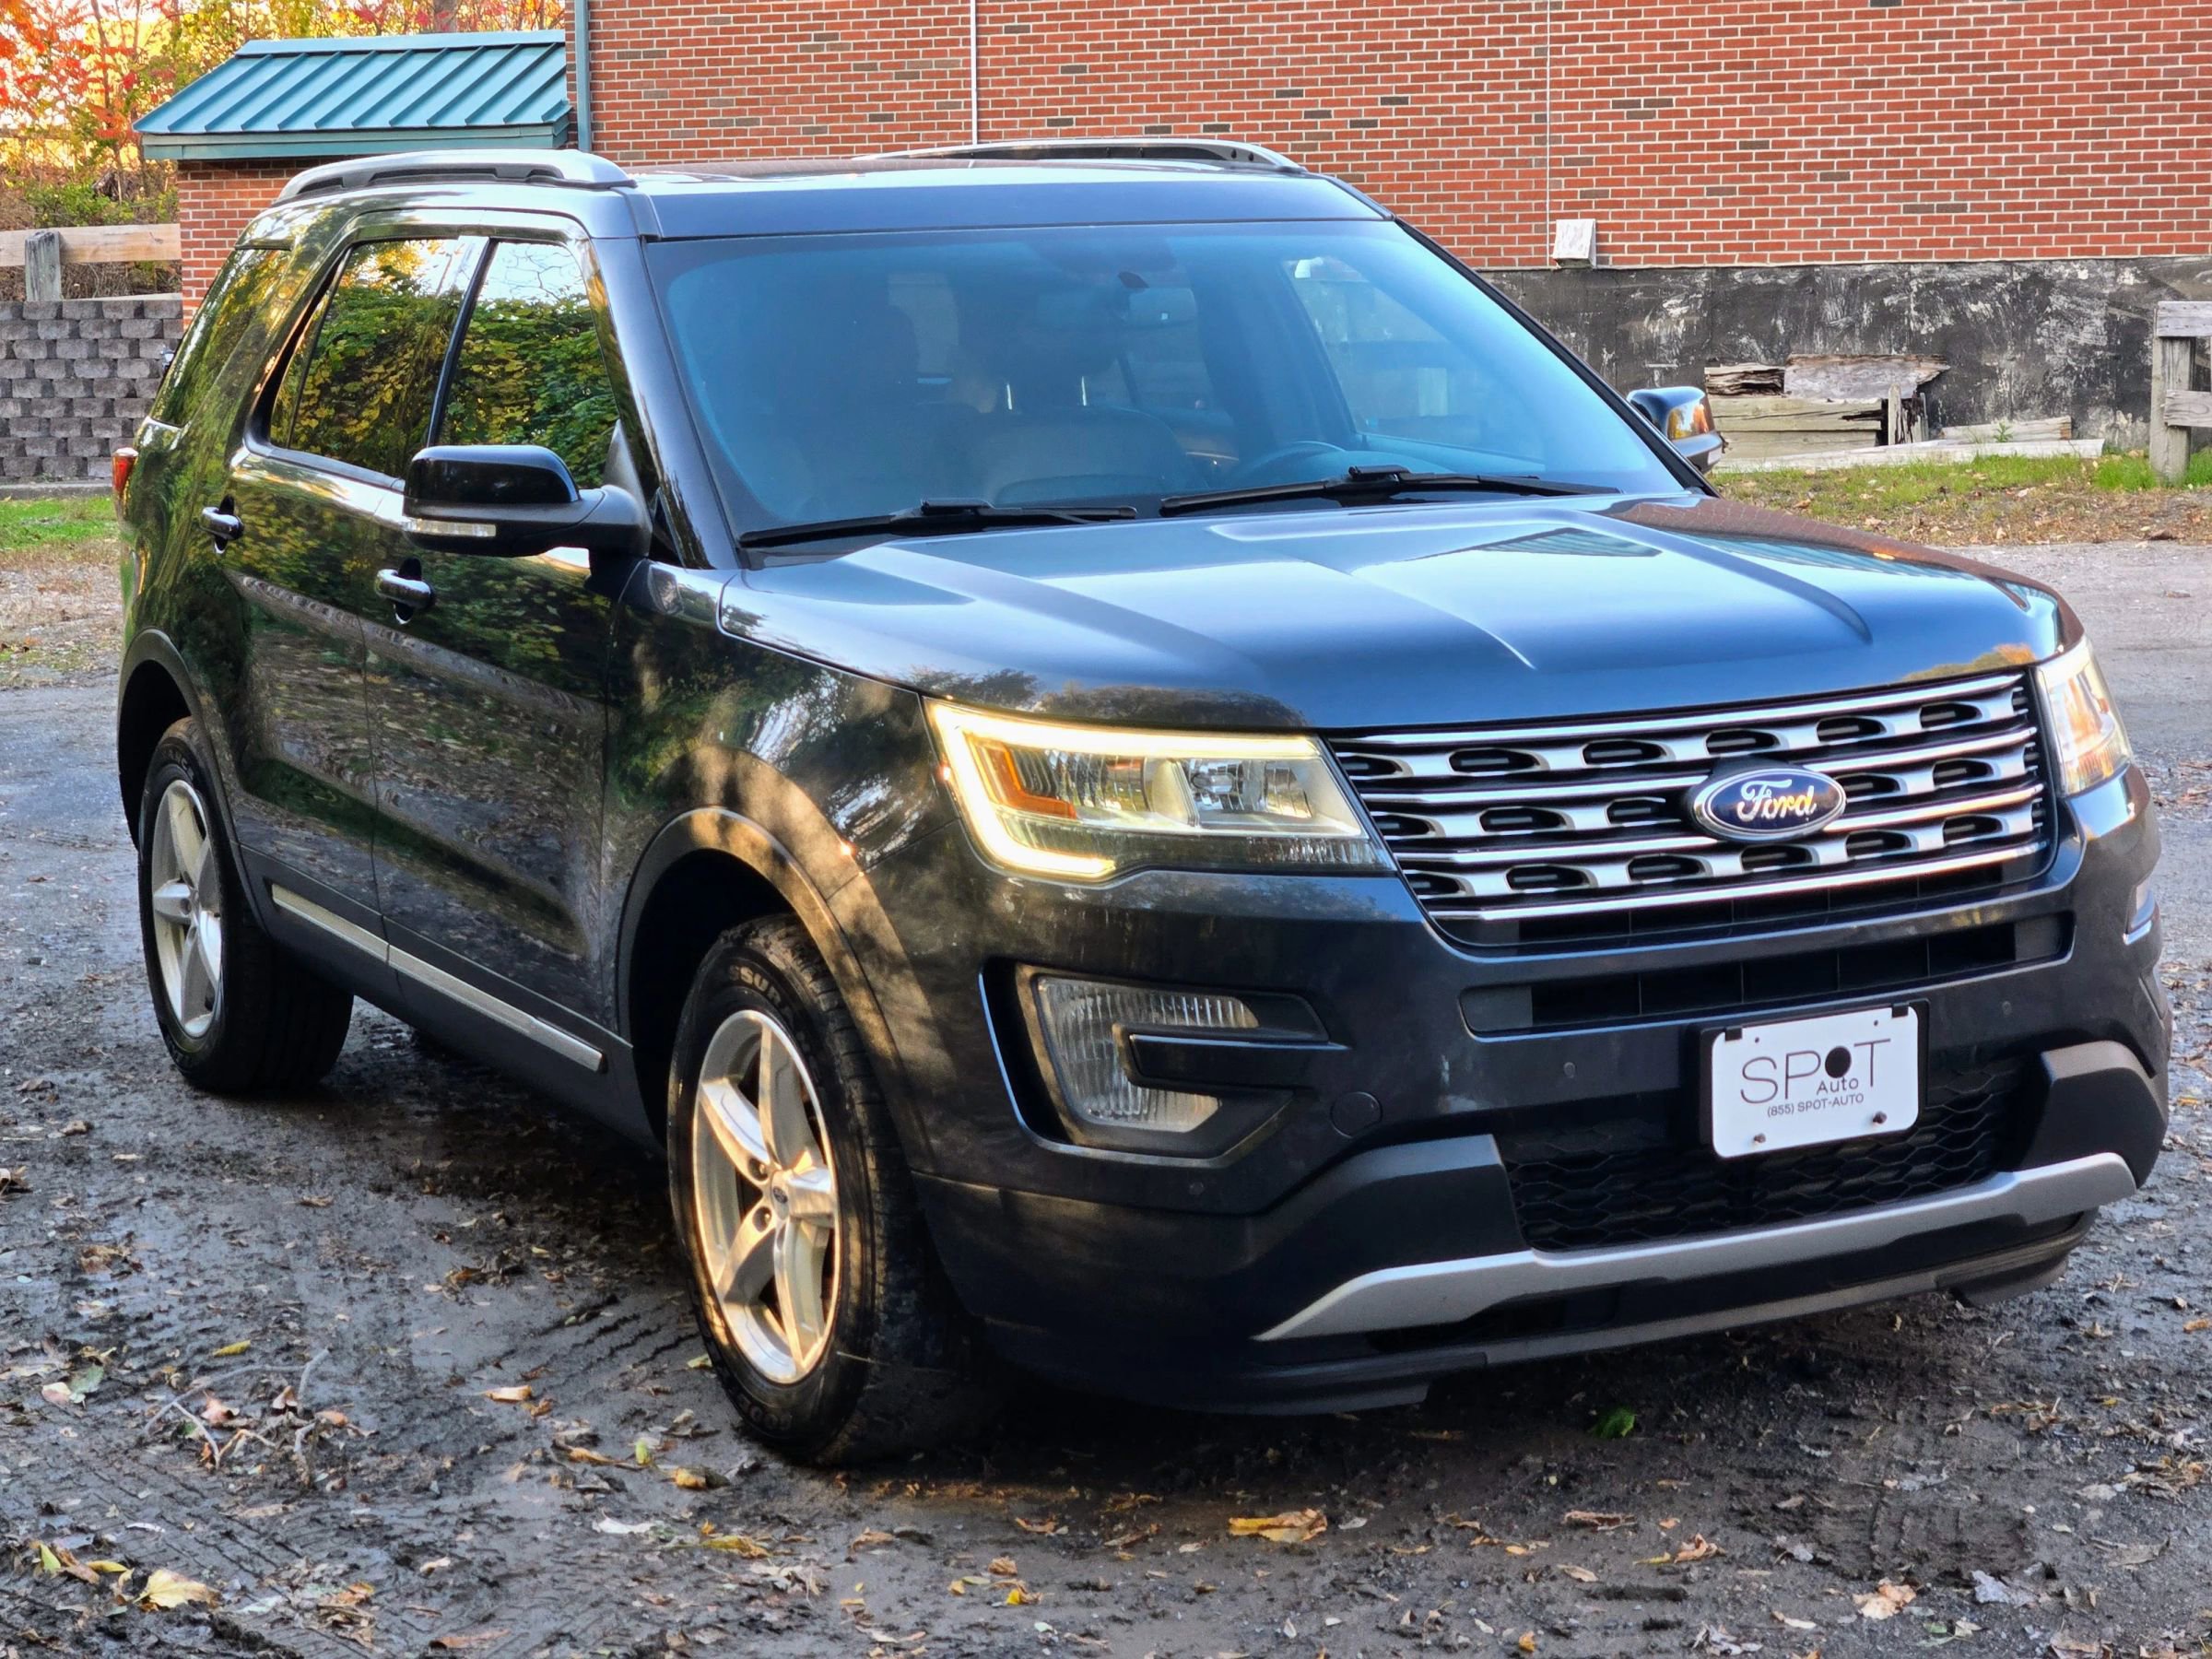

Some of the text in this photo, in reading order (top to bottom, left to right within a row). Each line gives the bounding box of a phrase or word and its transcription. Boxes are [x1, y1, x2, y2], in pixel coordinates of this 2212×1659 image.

[1736, 779, 1818, 822] Ford
[1740, 1038, 1891, 1104] SPOT
[1816, 1077, 1859, 1095] Auto
[1767, 1094, 1864, 1117] (855) SPOT-AUTO
